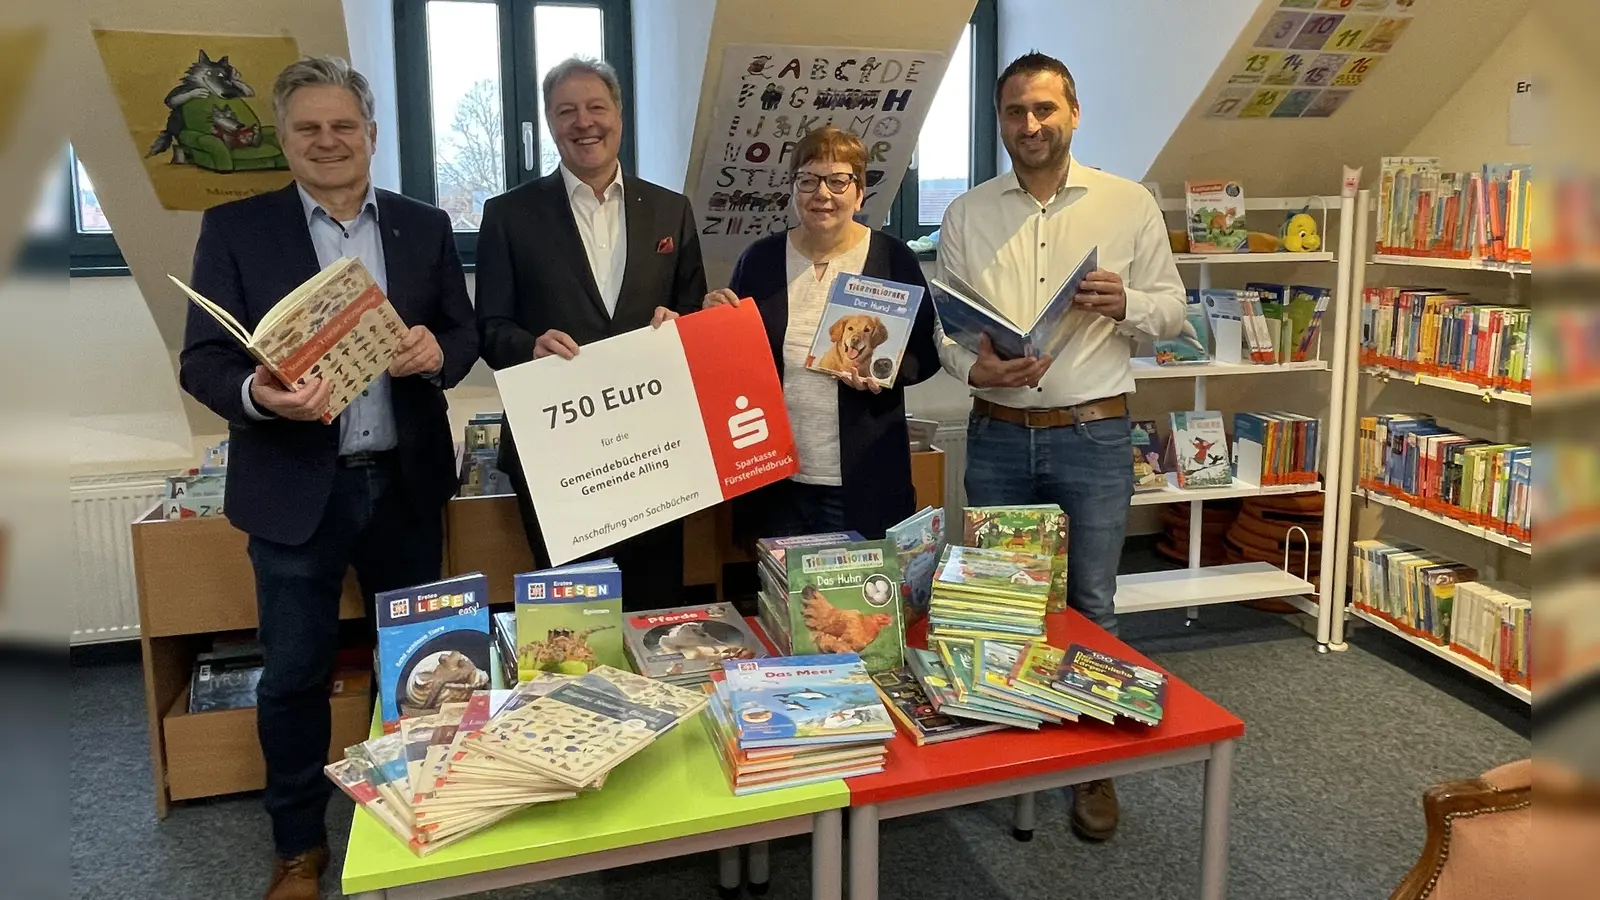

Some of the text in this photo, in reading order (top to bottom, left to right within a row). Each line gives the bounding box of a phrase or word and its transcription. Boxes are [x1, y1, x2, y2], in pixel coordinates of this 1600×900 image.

[1275, 16, 1362, 47] 9 10 11
[778, 58, 925, 83] A B C D E
[1245, 54, 1372, 83] 13 14 15 16
[789, 86, 809, 108] G
[881, 89, 913, 111] H
[1215, 98, 1242, 114] 17
[1256, 91, 1279, 105] 18
[746, 115, 765, 138] J
[745, 142, 771, 164] O
[716, 166, 737, 188] S
[740, 168, 766, 188] T
[702, 217, 725, 235] Z
[854, 298, 891, 313] Der Hund
[542, 378, 662, 429] 750 Euro
[601, 431, 629, 448] für die
[560, 439, 682, 488] Gemeindebücherei der
[735, 449, 777, 470] Sparkasse
[581, 458, 670, 496] Gemeinde Alling
[724, 455, 793, 486] Fürstenfeldbruck
[177, 487, 184, 496] A
[572, 491, 699, 545] Anschaffung von Sachbüchern
[817, 573, 862, 586] Das Huhn
[417, 593, 437, 601] Erstes
[553, 584, 608, 598] LESEN
[417, 592, 475, 612] LESEN
[458, 602, 480, 616] easy!
[648, 612, 698, 624] Pferde
[428, 625, 445, 636] Tiere
[1075, 651, 1094, 661] Der
[1092, 651, 1114, 664] 100
[796, 668, 834, 677] Meer
